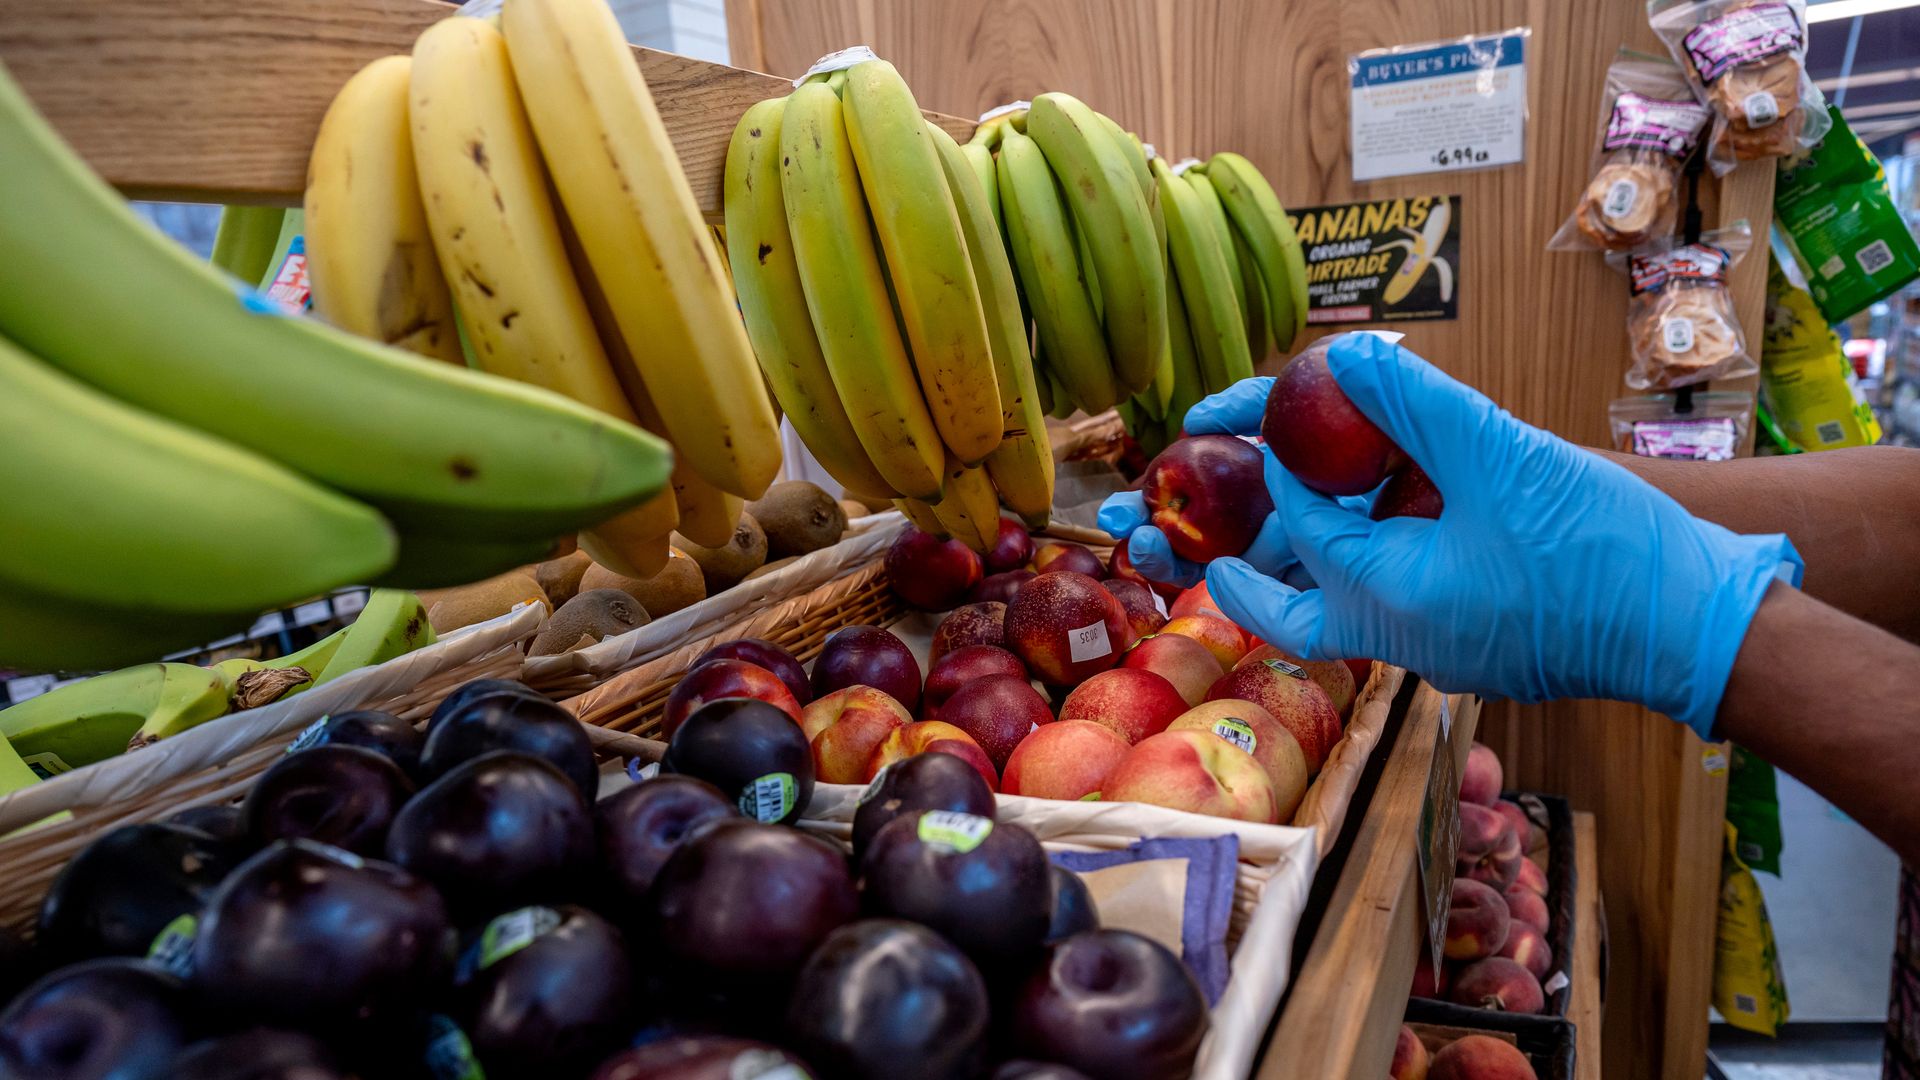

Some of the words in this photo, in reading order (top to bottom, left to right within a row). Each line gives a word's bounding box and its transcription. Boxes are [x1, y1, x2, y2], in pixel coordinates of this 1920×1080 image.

[1368, 55, 1445, 80] BUYER'S
[1309, 238, 1372, 261] ORGANIC
[1336, 276, 1380, 291] FARMER
[1320, 291, 1360, 306] GROWN
[1079, 627, 1098, 644] 3035
